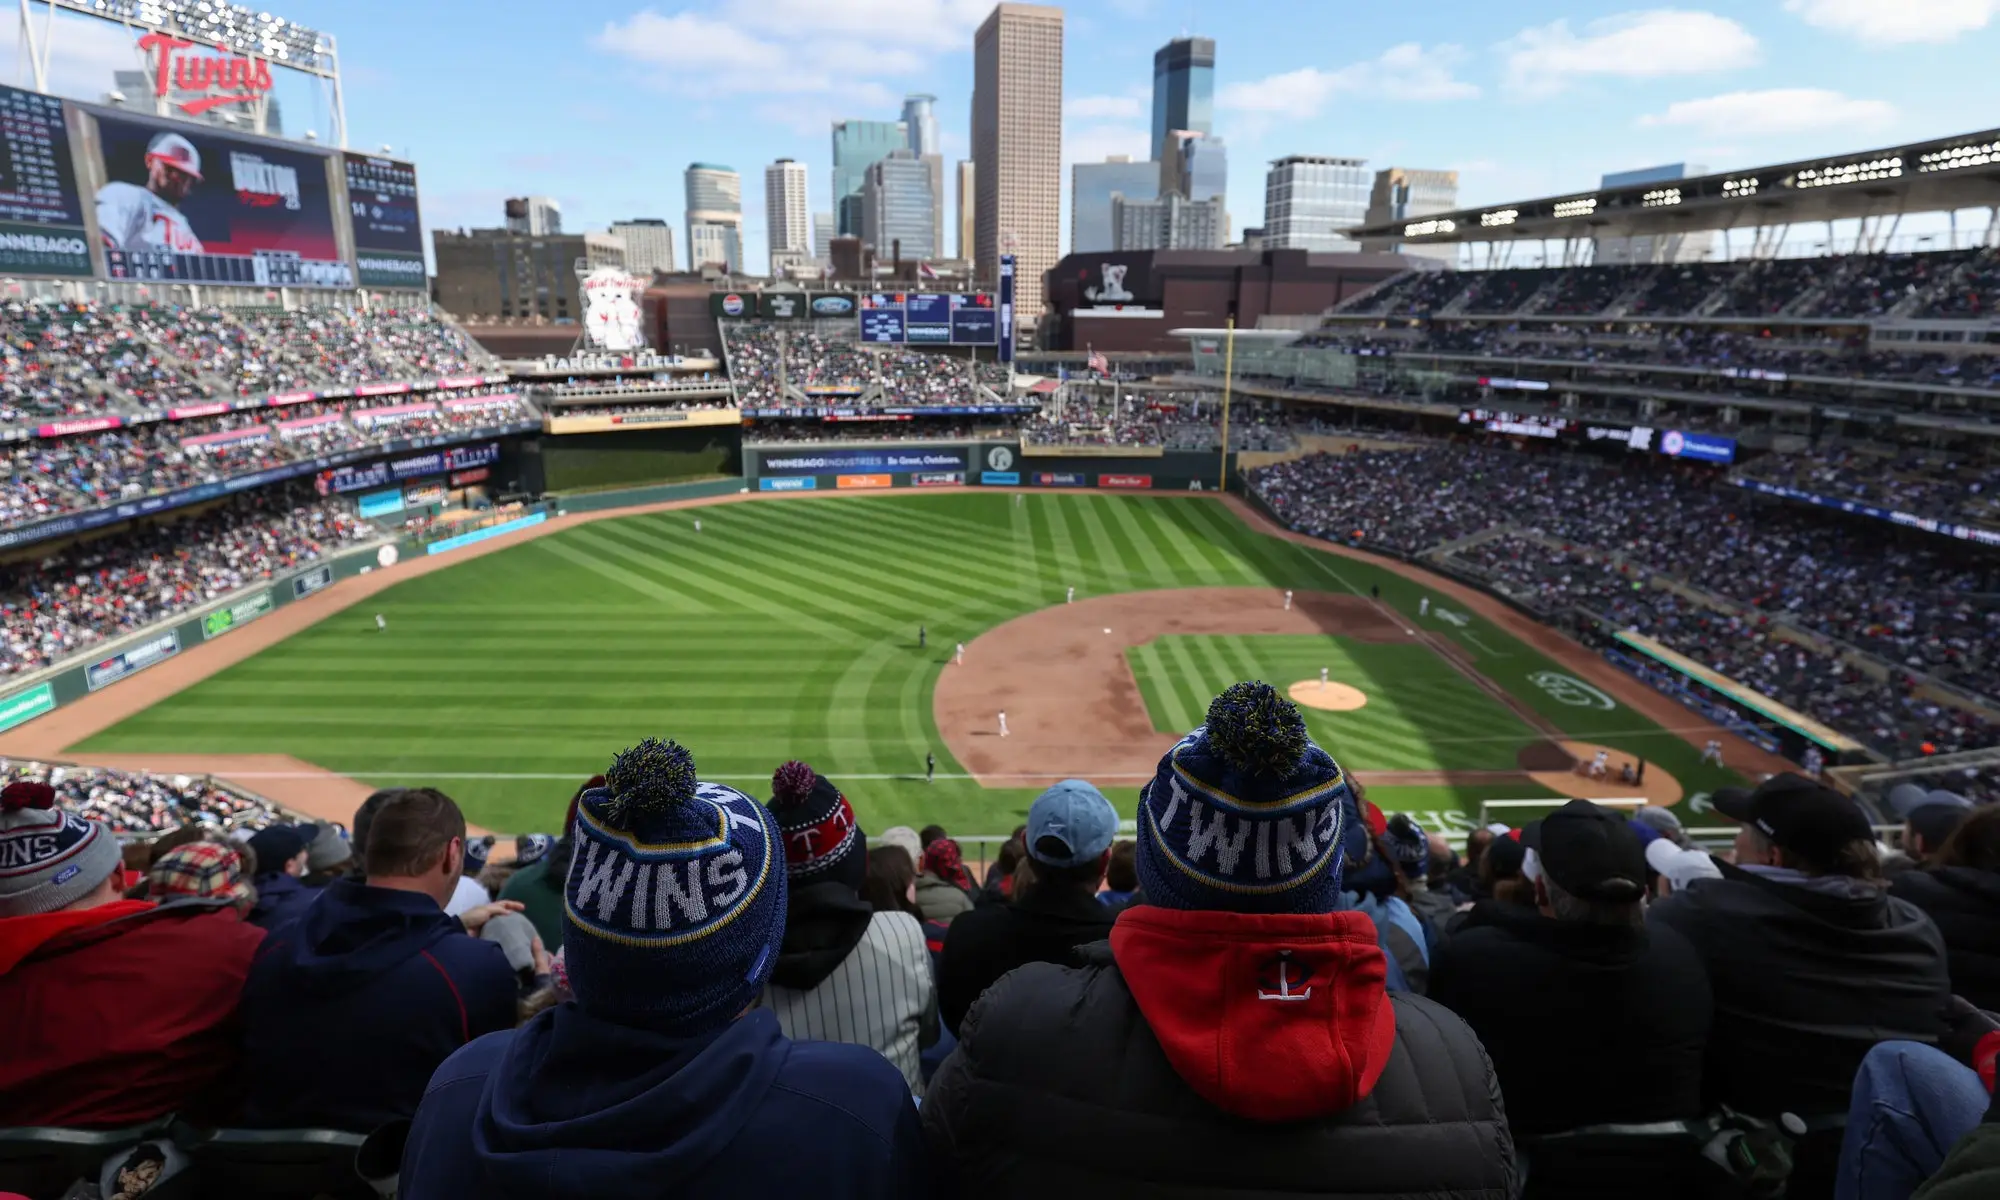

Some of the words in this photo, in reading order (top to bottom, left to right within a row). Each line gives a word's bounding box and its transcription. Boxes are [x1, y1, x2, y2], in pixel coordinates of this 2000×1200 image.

[138, 33, 273, 98] Twins
[357, 258, 424, 274] WINNEBAGO
[391, 454, 439, 470] WINNEBAGO
[767, 458, 824, 469] WINNEBAGO
[824, 457, 882, 468] INDUSTRIES
[1053, 471, 1075, 483] bank
[1160, 775, 1339, 878] TWINS
